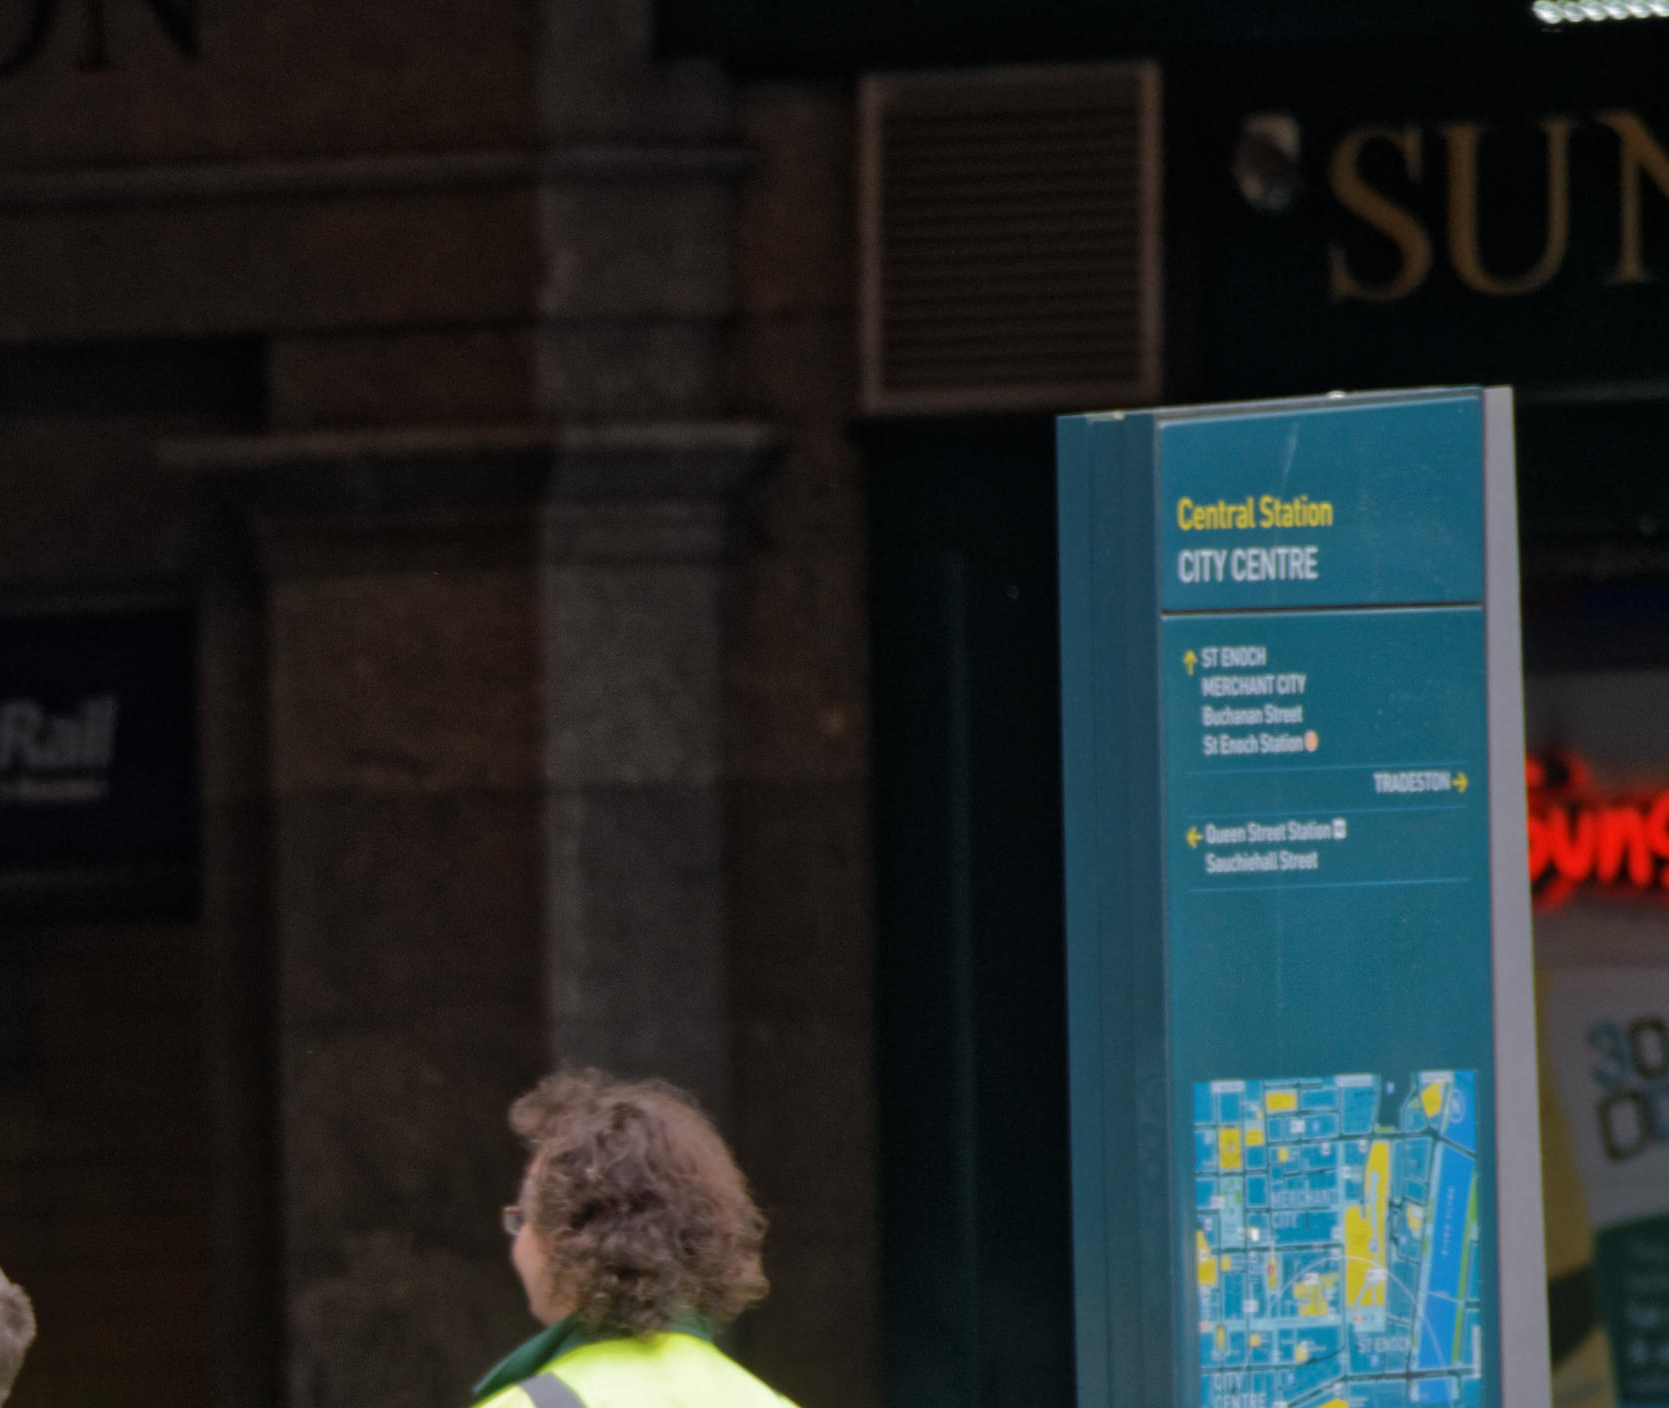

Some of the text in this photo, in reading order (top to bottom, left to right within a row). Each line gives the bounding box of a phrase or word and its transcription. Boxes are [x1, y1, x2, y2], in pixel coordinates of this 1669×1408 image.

[1177, 495, 1333, 531] Central Station
[1177, 546, 1319, 583] CITY CENTRE
[1201, 646, 1267, 668] ST ENOCH
[1201, 673, 1306, 697] MERCHANT CITY
[1202, 703, 1304, 726] Buchanan Street
[1203, 732, 1304, 755] St Enoch Station
[1372, 770, 1451, 793] TRADESTON
[1204, 820, 1331, 845] Queen Street Station
[1205, 850, 1318, 873] Sauchiehall Street
